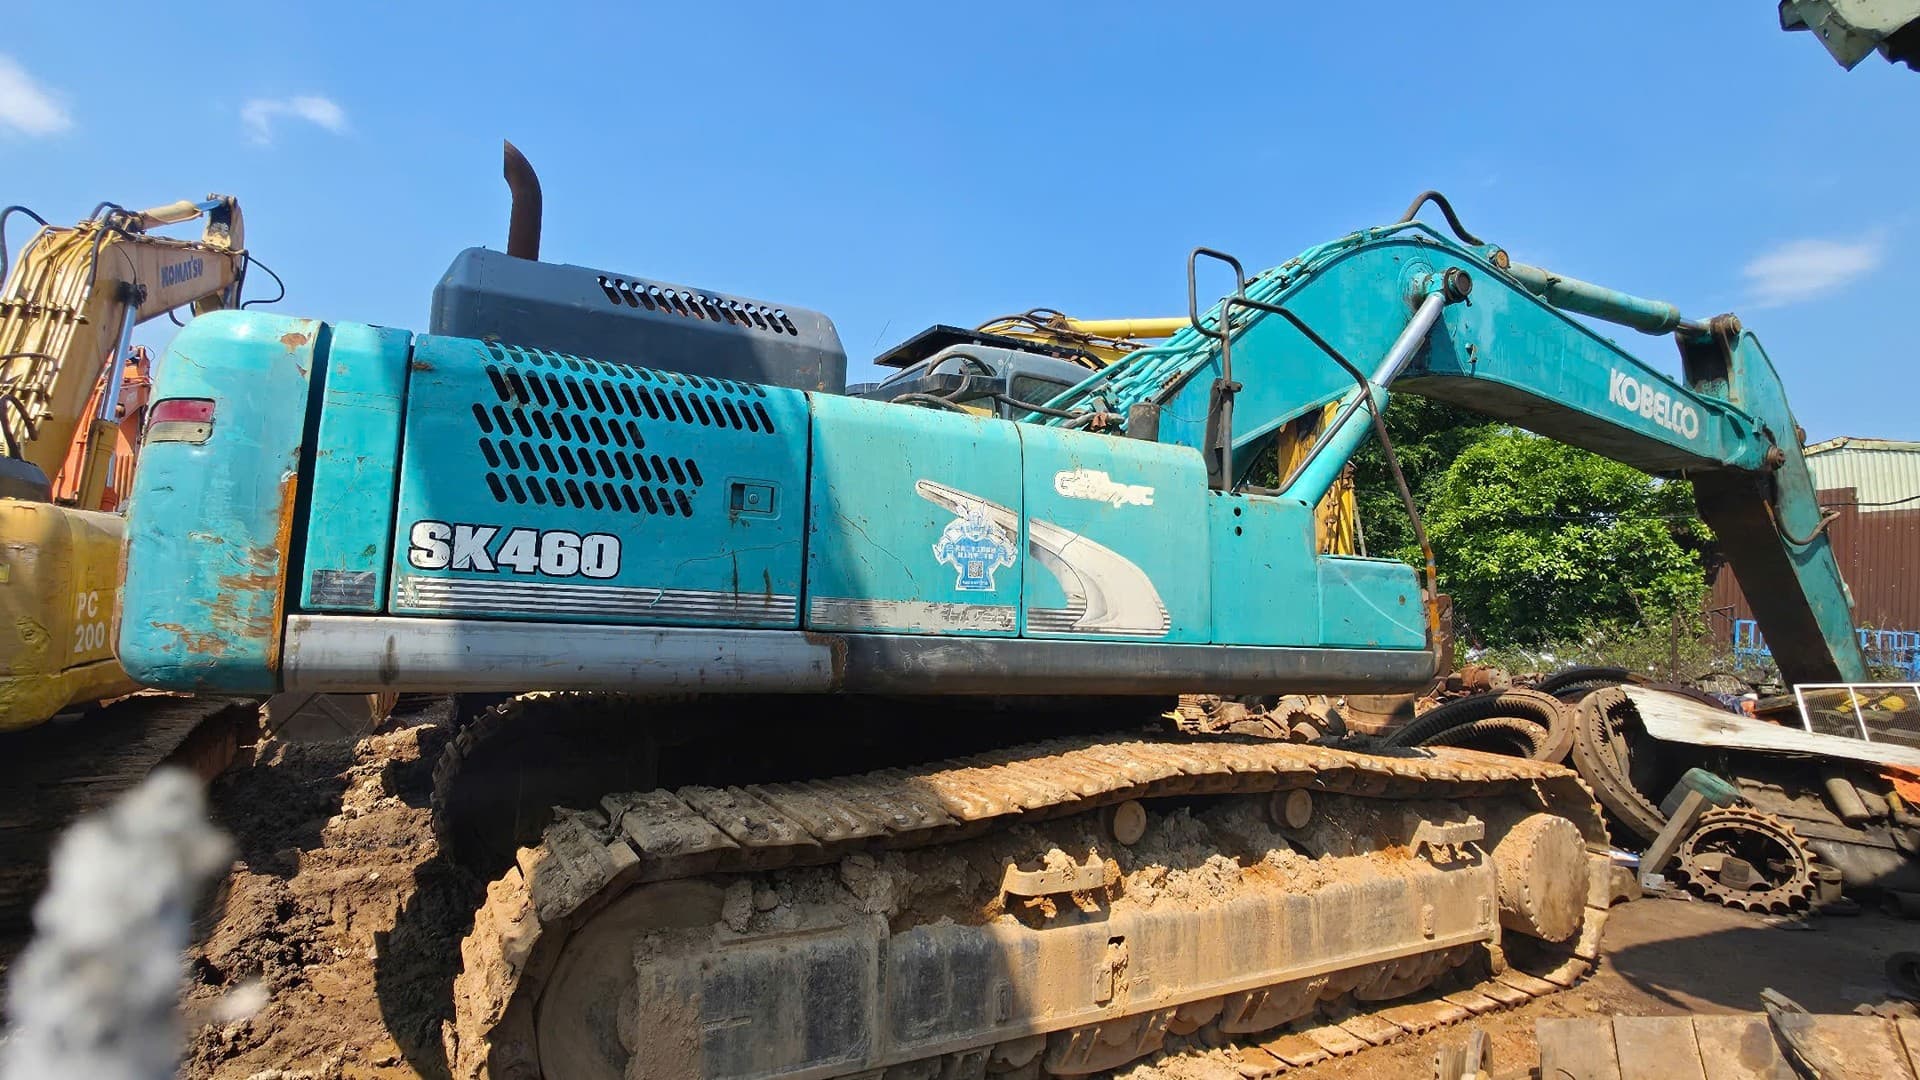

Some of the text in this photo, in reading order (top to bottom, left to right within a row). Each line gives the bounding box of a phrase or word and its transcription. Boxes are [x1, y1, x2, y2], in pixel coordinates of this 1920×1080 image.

[161, 255, 203, 288] KOMATSU
[1609, 367, 1699, 439] KOBELCO
[408, 520, 622, 579] SK460
[75, 590, 99, 619] PC
[74, 621, 105, 653] 200
